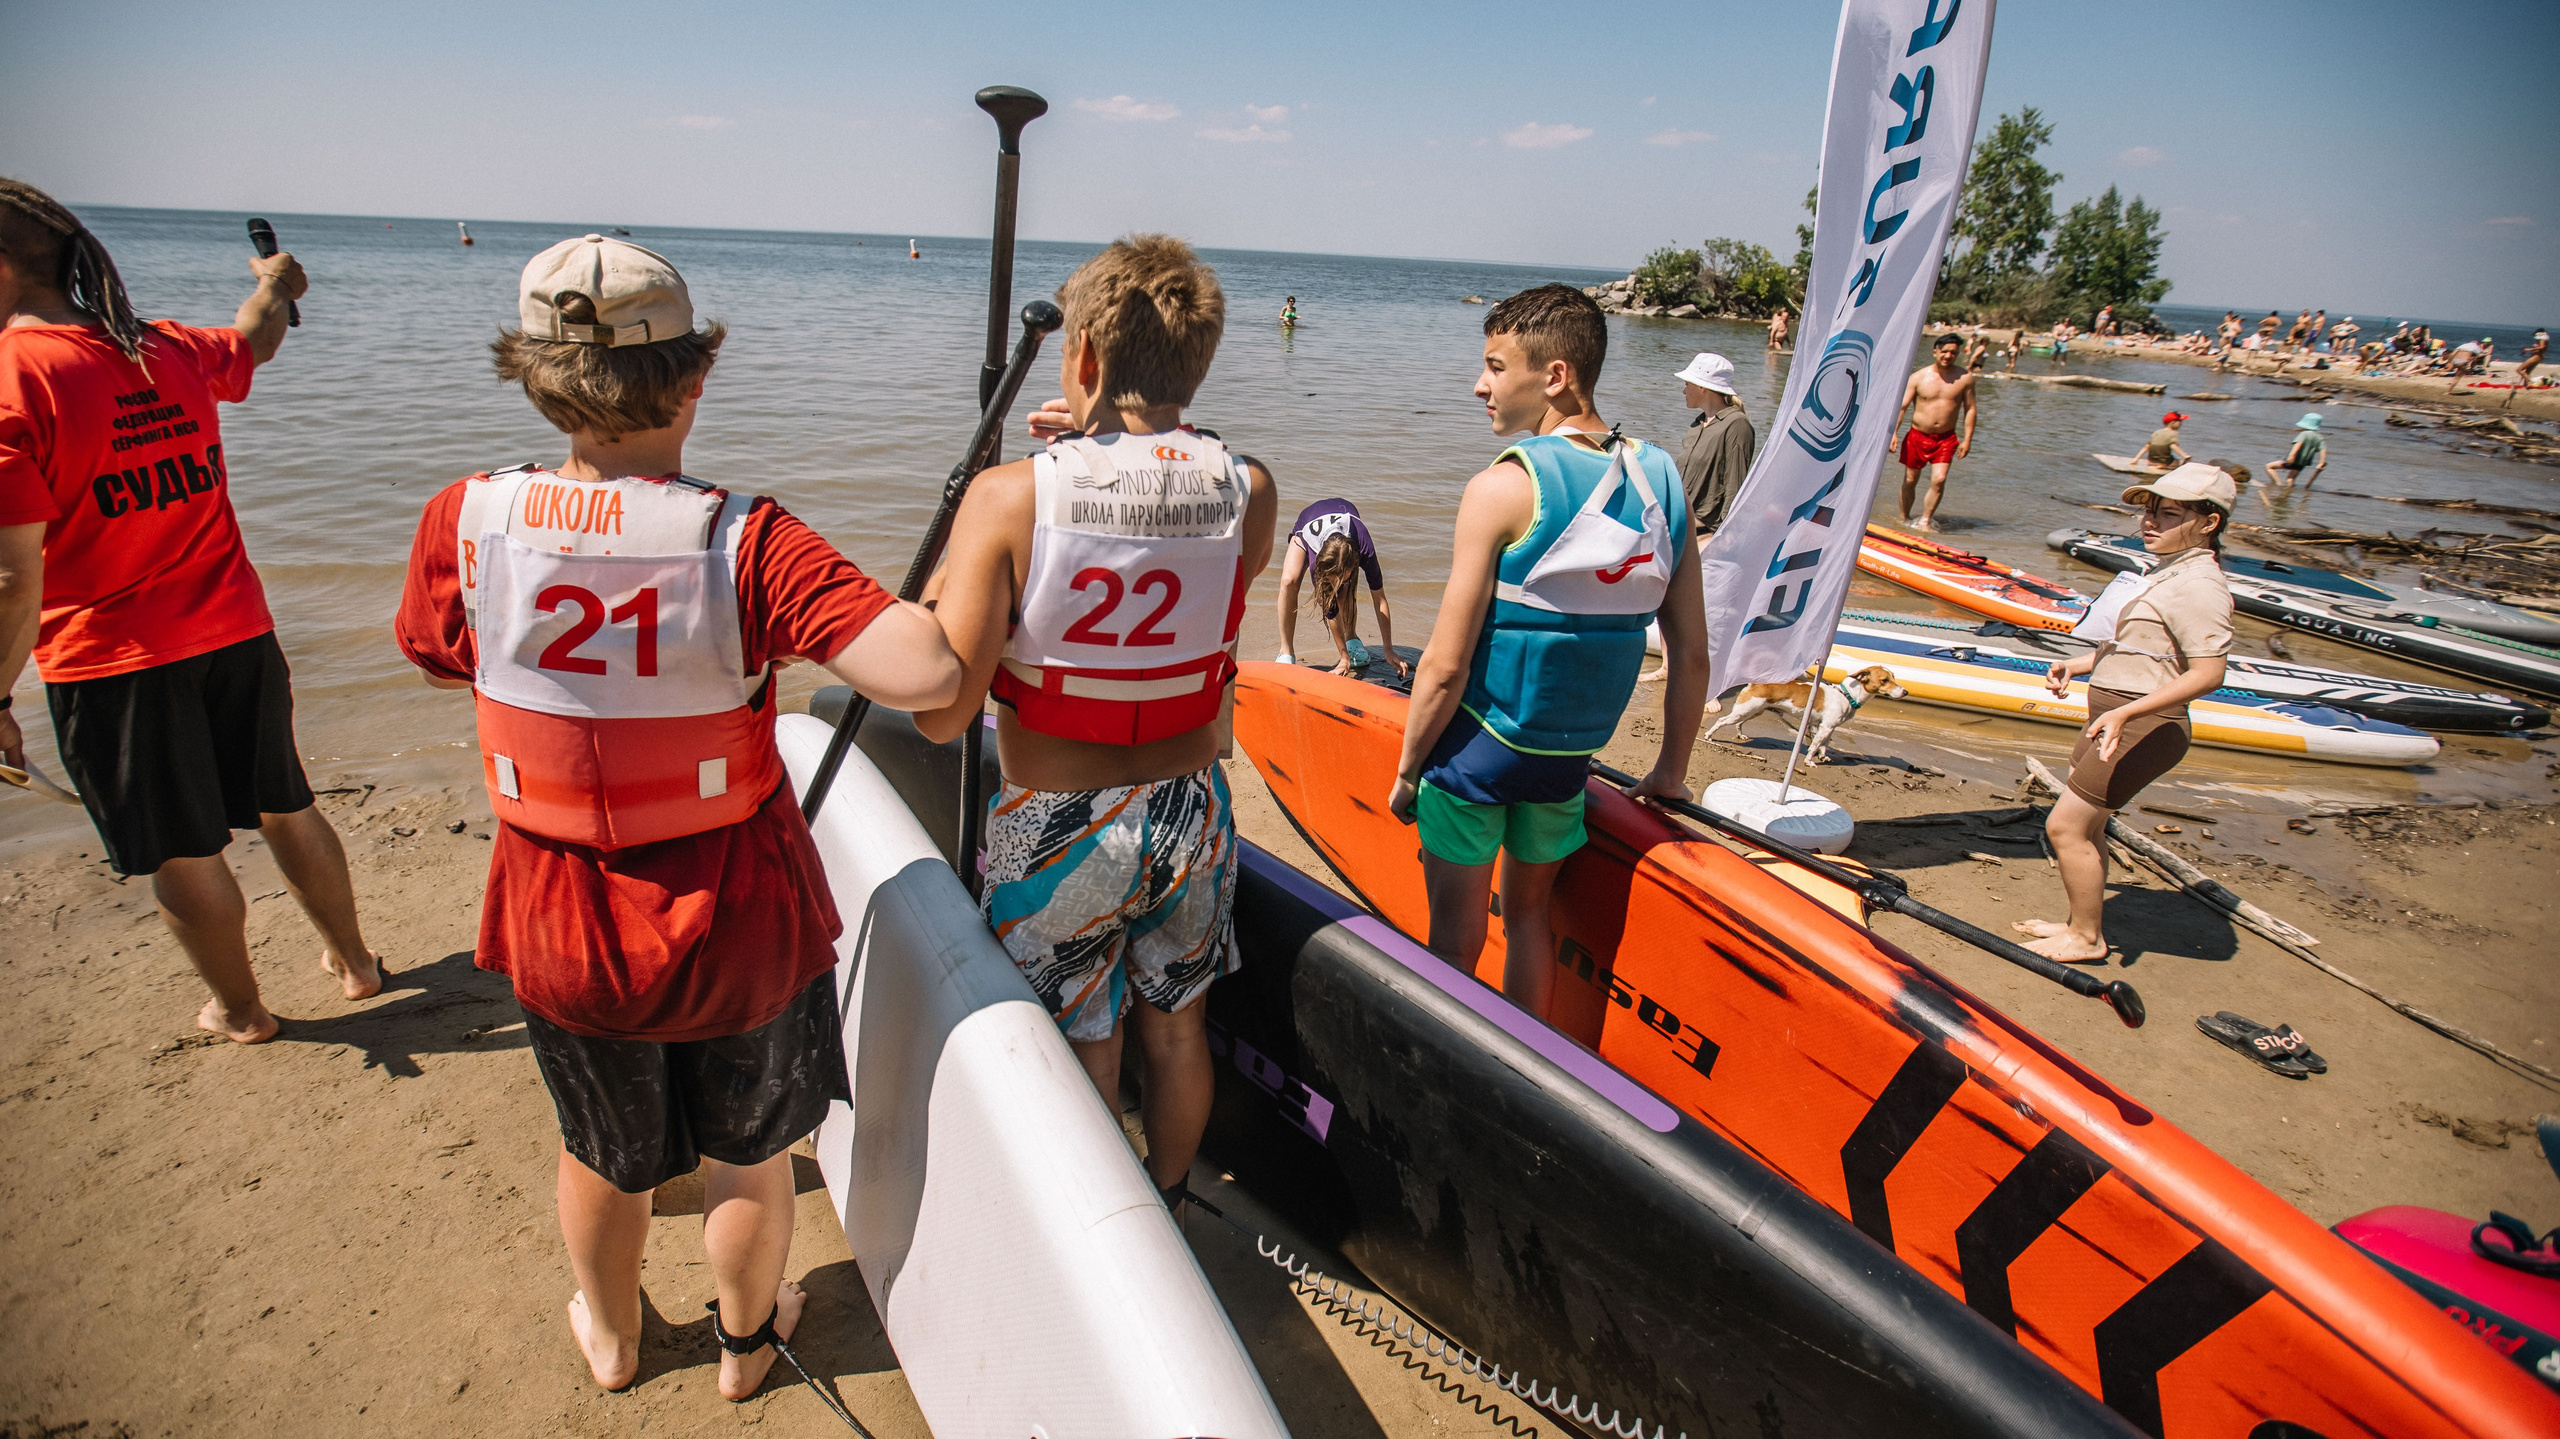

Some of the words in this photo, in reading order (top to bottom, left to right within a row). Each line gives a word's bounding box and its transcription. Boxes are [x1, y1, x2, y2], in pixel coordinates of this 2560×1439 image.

[112, 403, 186, 430] ФЕДЕРАЦИЯ
[92, 443, 223, 519] СУДЬЯ
[524, 482, 625, 536] ШКОЛА
[1071, 500, 1115, 525] ШКОЛА
[1120, 502, 1192, 527] ПАРУСНОГО
[1196, 500, 1236, 526] СПОРТА
[535, 584, 658, 677] 21
[1062, 567, 1182, 647] 22
[2281, 611, 2343, 635] AQUA
[2353, 628, 2397, 648] INC.
